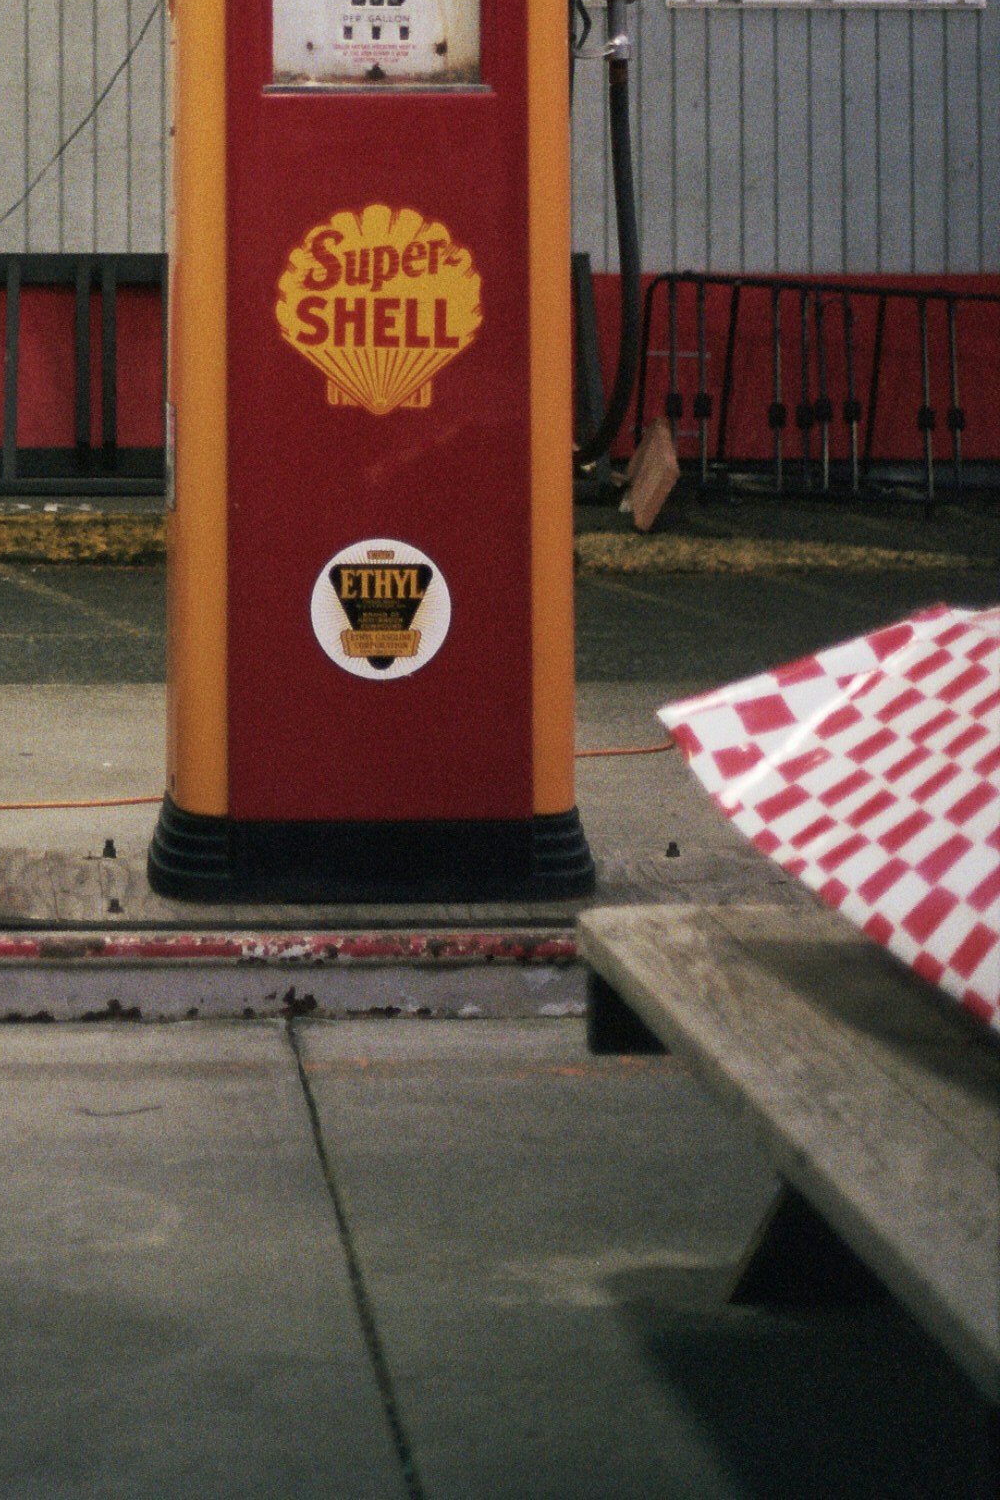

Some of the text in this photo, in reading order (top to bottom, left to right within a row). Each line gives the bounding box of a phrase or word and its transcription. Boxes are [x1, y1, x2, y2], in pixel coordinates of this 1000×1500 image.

[343, 14, 410, 23] PER GALLON
[295, 297, 460, 349] SHELL
[340, 569, 424, 599] ETHYL
